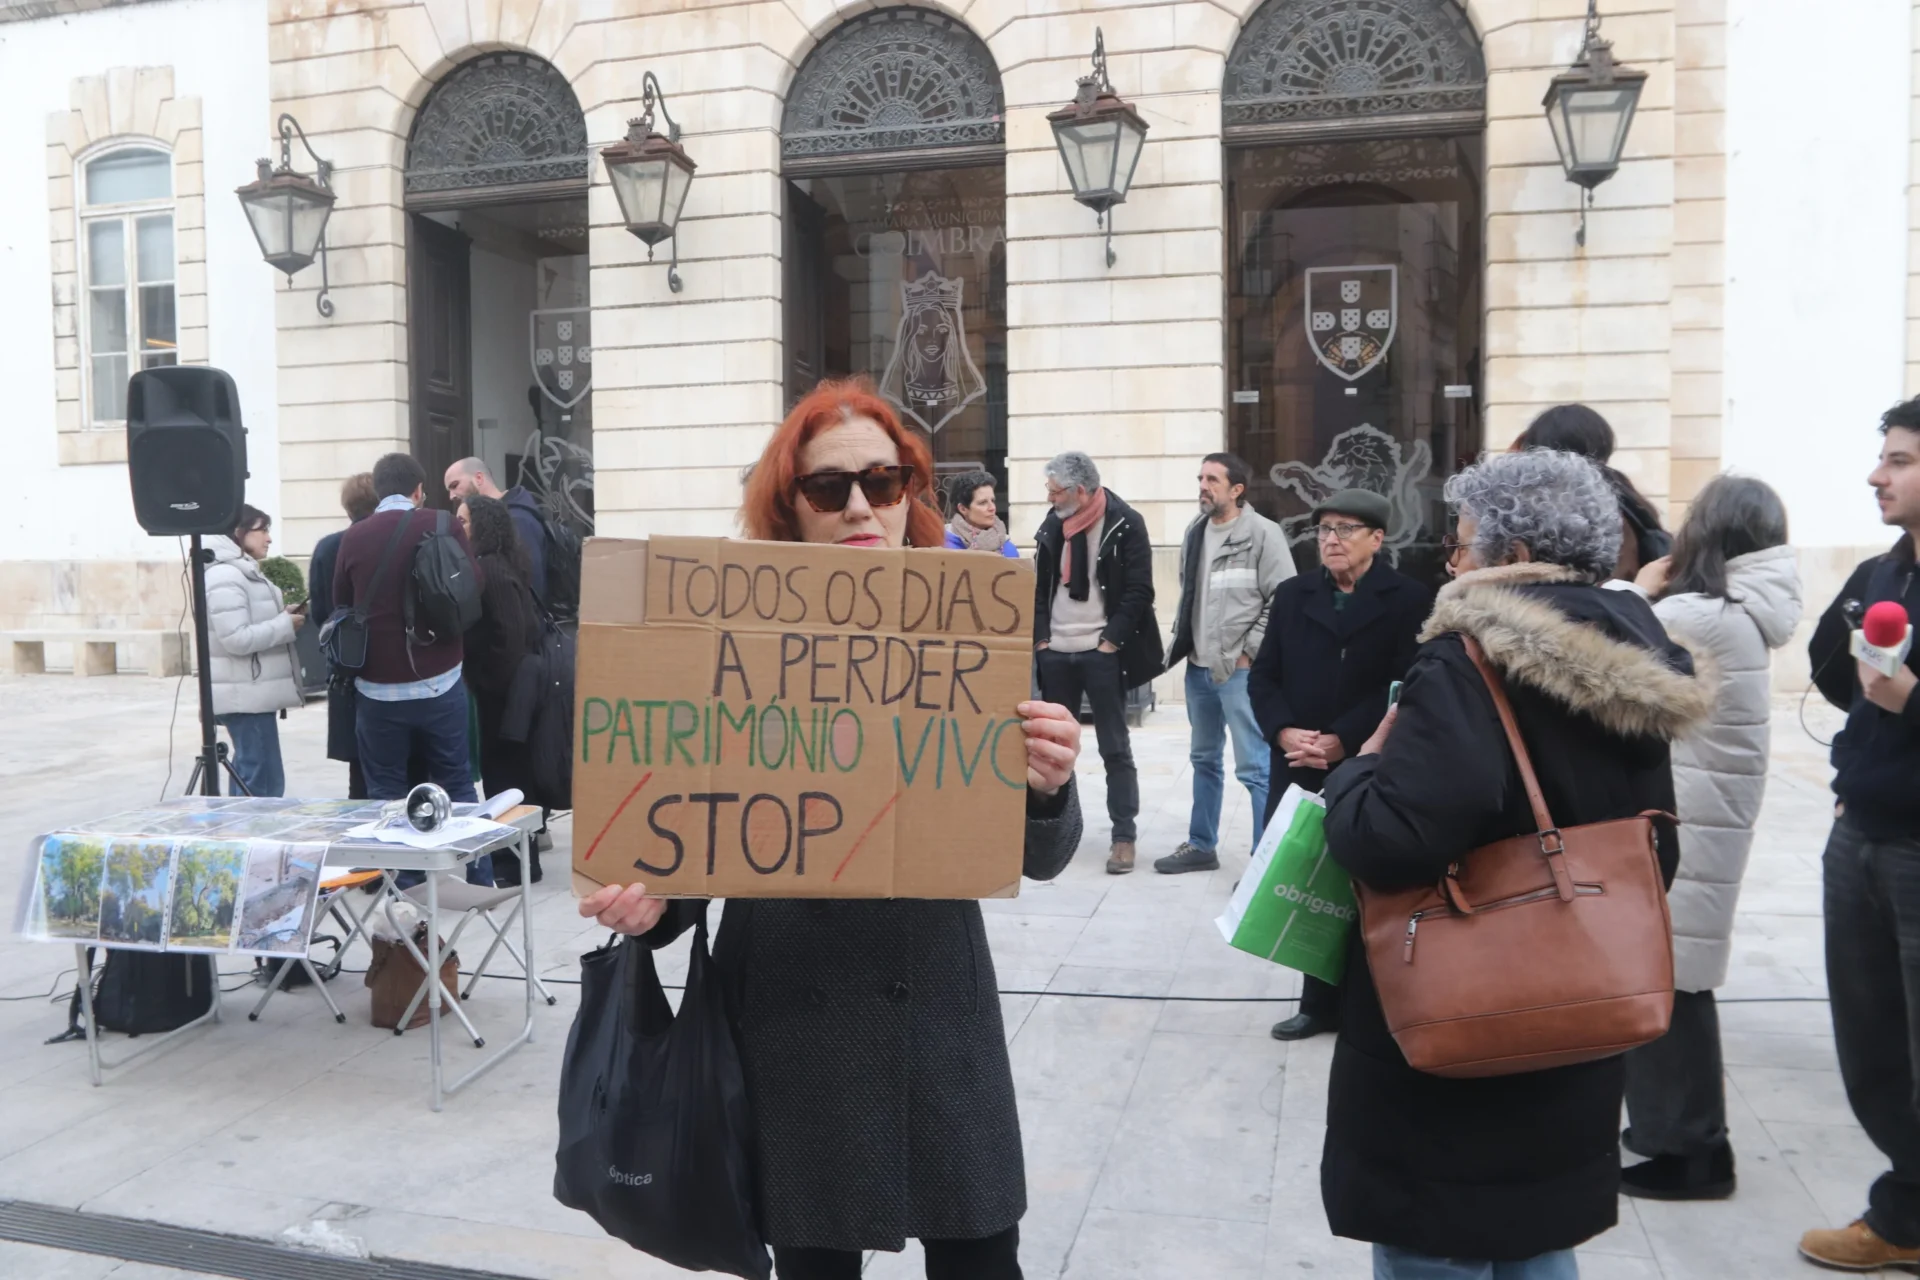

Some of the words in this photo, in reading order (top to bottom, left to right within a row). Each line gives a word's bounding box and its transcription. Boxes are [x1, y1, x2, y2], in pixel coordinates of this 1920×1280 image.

[854, 224, 1006, 258] COIMBRA
[655, 554, 809, 624] TODOS
[825, 566, 884, 631] OS
[712, 630, 752, 700] A
[778, 632, 989, 714] PERDER
[1274, 884, 1357, 921] obrigado
